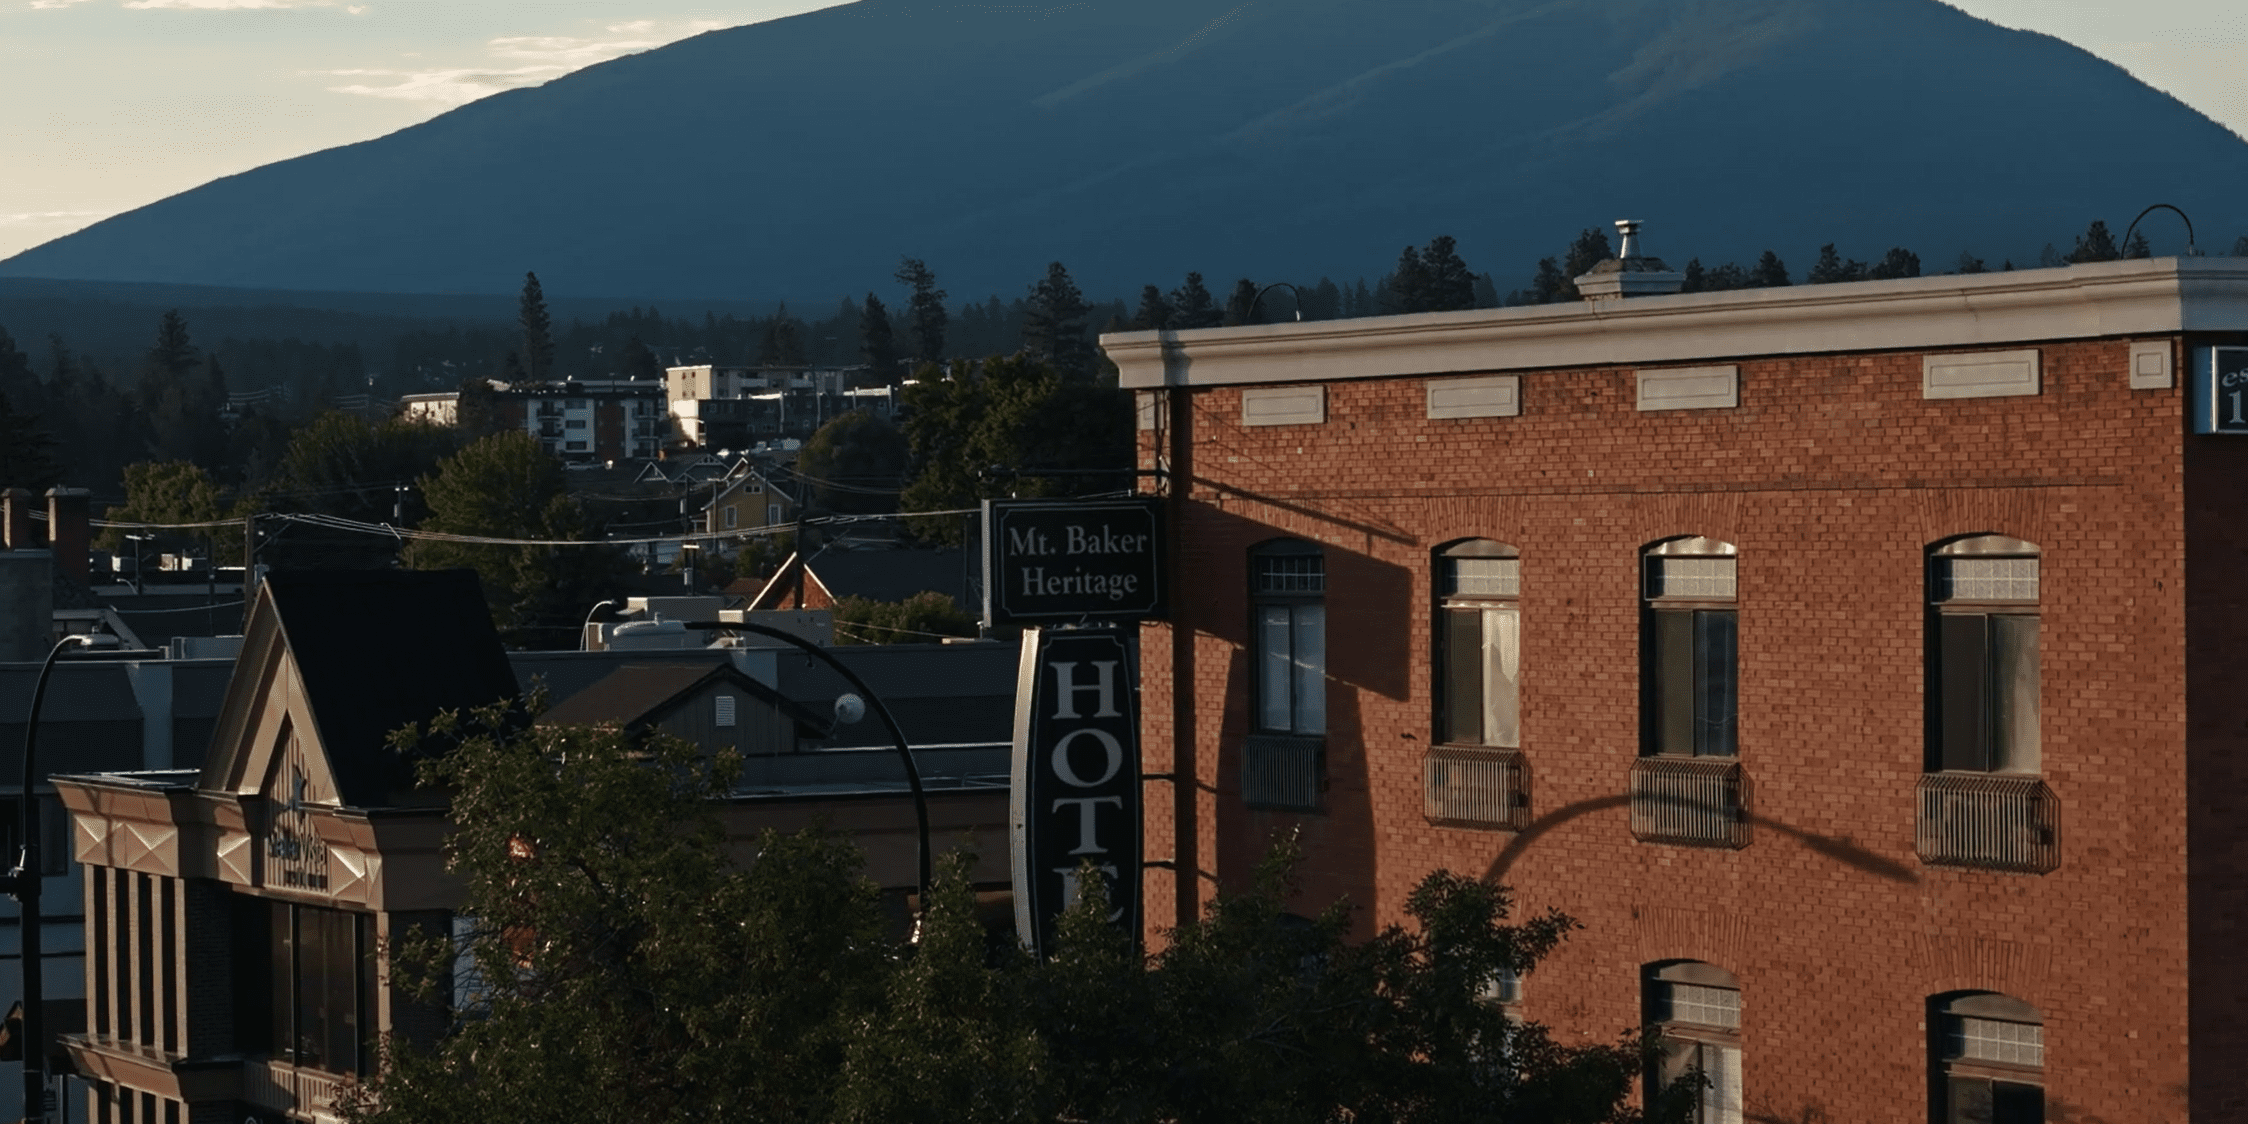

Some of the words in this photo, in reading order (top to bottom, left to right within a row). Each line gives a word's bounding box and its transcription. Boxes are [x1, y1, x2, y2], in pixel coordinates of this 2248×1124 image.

[1009, 526, 1057, 556] Mt.
[1066, 523, 1148, 555] Baker
[1021, 566, 1138, 601] Heritage
[1049, 660, 1125, 924] HOTE
